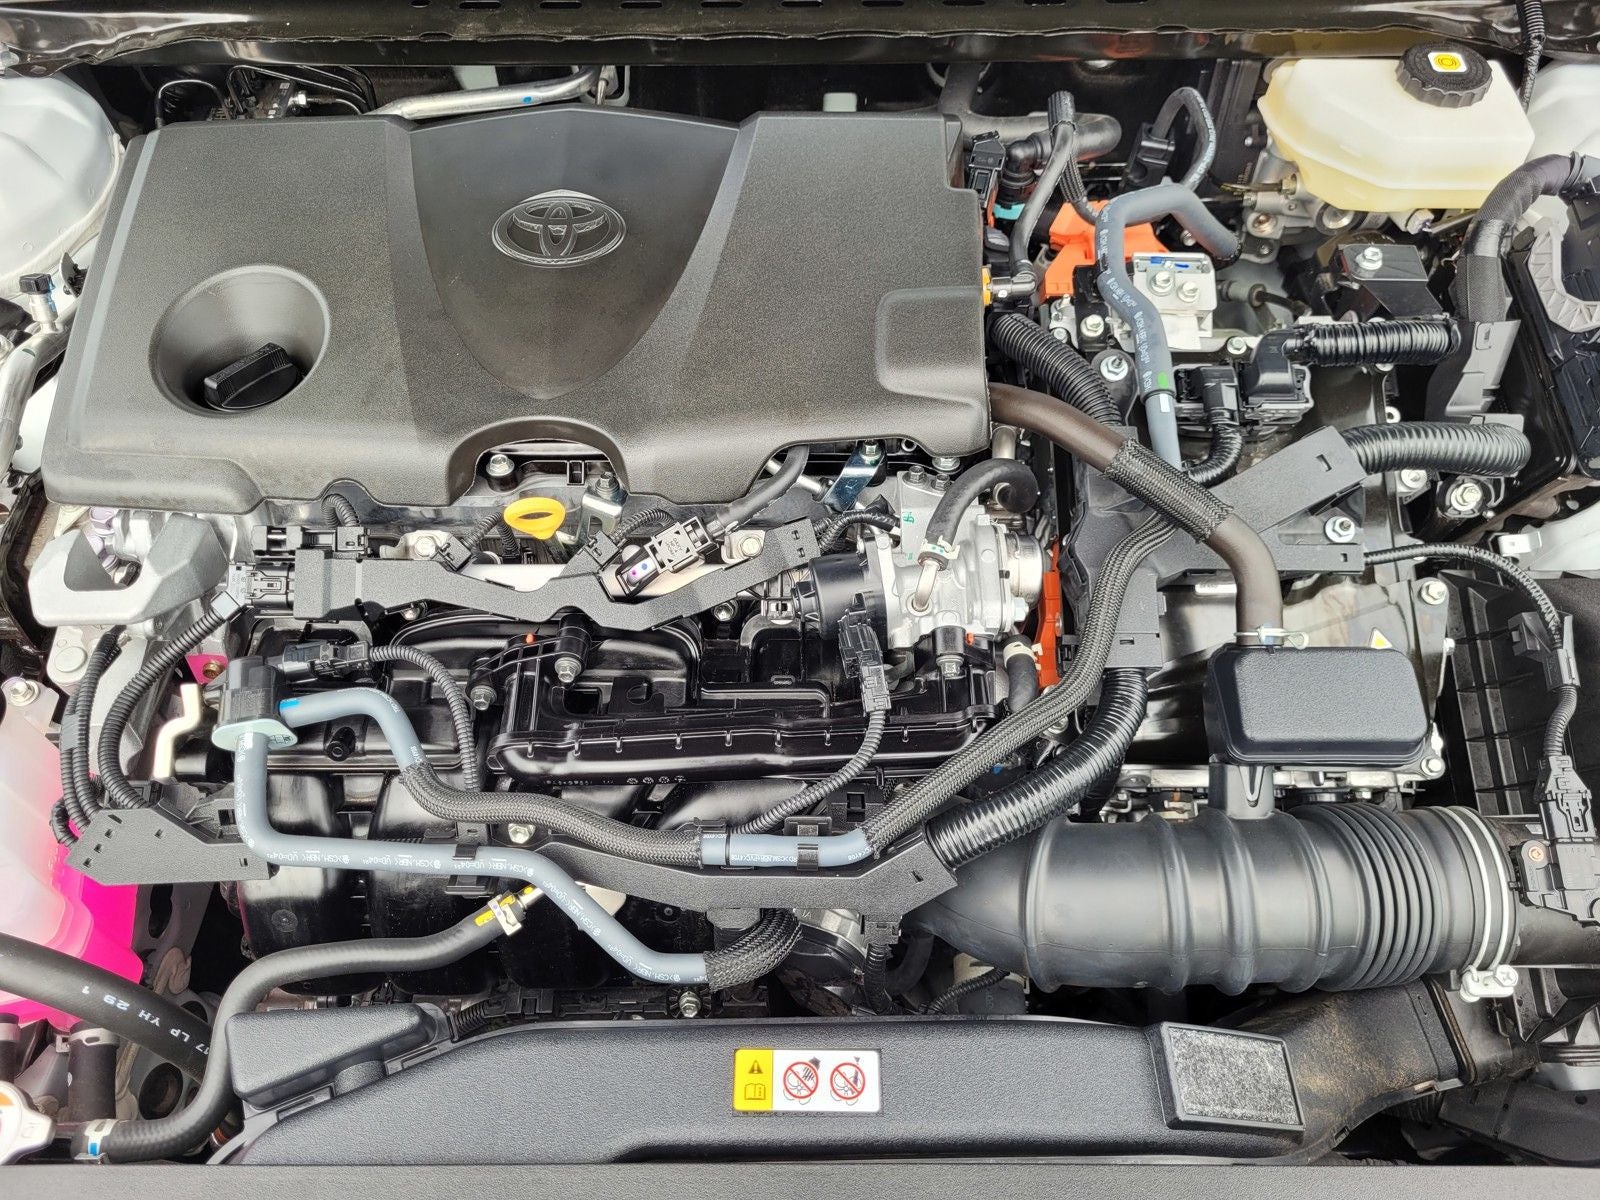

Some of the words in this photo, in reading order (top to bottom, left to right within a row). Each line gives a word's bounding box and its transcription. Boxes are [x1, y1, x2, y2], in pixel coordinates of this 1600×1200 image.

[103, 994, 130, 1011] 29
[138, 1010, 161, 1027] YH
[170, 1029, 191, 1042] LP
